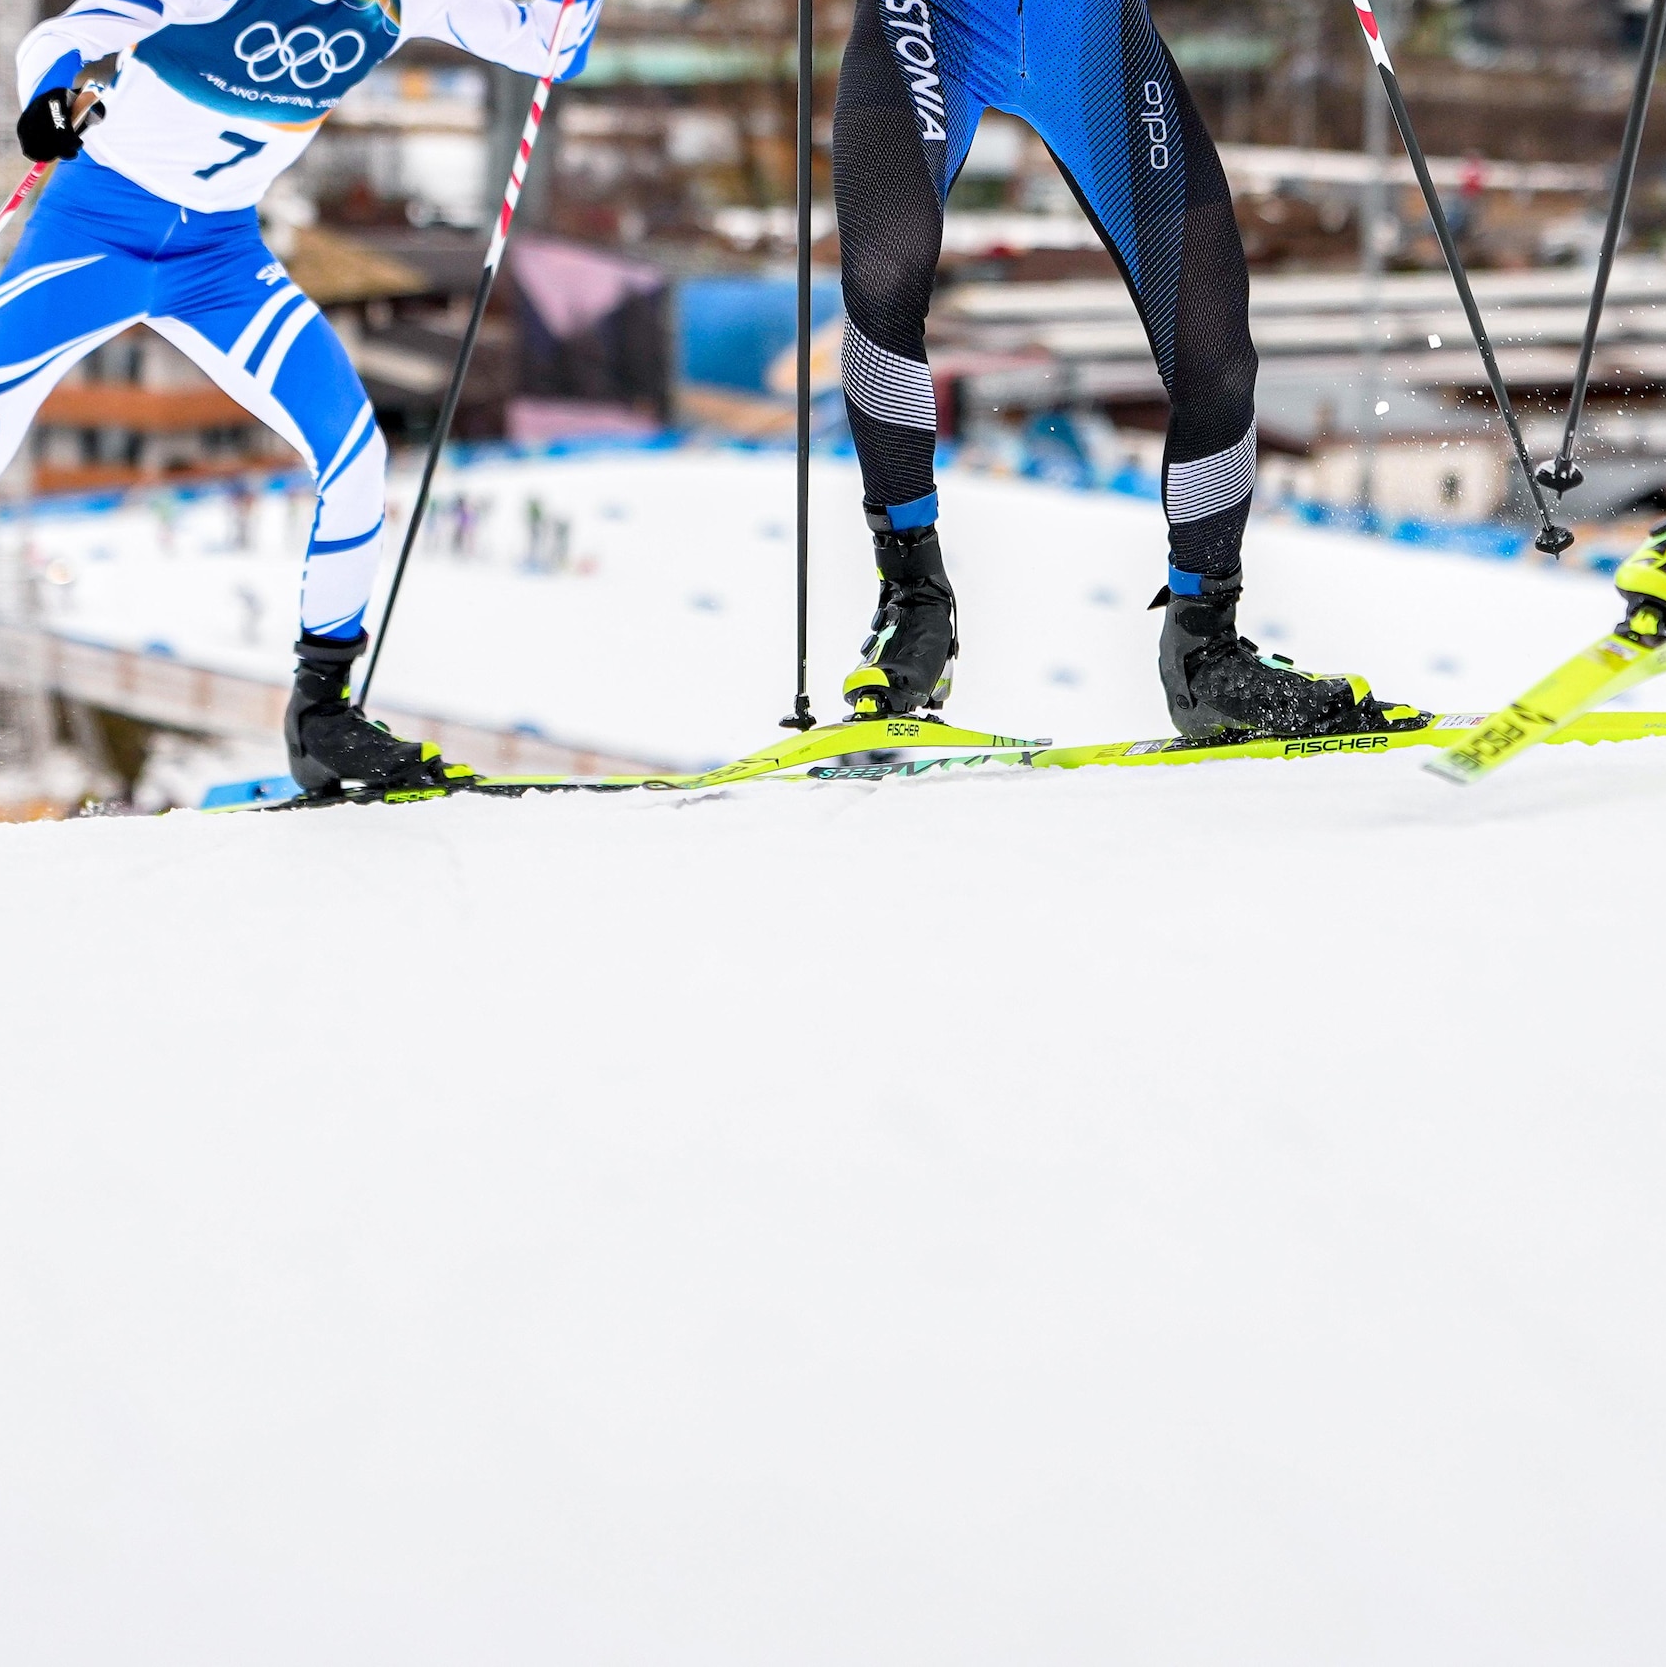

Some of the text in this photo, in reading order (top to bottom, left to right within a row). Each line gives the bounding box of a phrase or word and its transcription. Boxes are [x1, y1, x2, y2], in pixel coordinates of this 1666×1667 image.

[199, 72, 258, 101] MILANO
[1141, 80, 1168, 170] odlo
[192, 130, 268, 181] 7
[887, 723, 920, 738] FISCHER
[1285, 736, 1388, 755] FISCHER
[819, 766, 893, 779] SPEED
